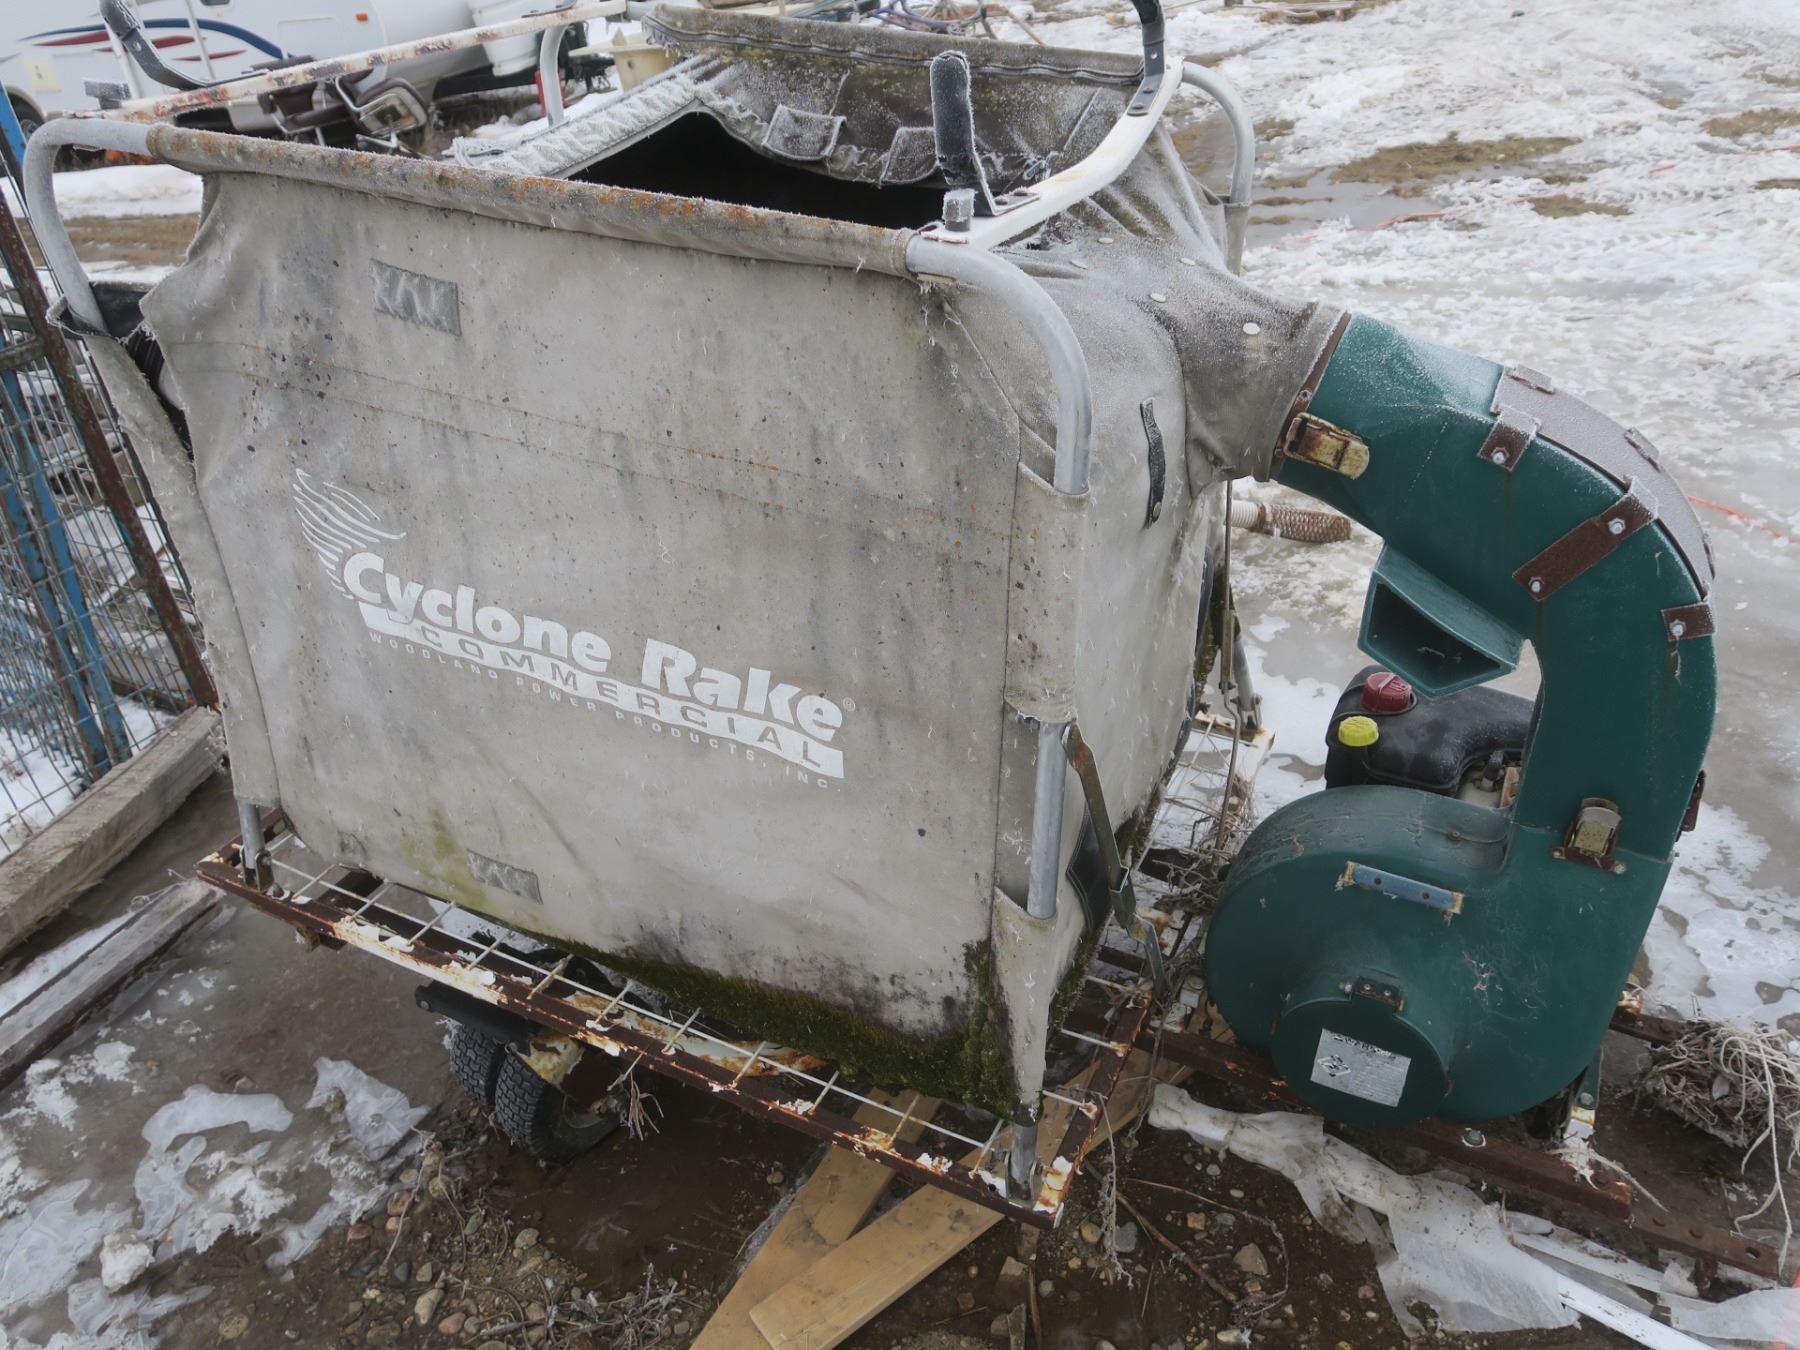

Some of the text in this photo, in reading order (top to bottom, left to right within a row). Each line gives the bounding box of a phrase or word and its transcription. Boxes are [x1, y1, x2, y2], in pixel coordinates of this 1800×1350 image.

[344, 552, 612, 673] Cyclone
[369, 631, 498, 679] WOODLAND
[516, 676, 596, 712] POWER
[420, 625, 822, 768] COMMERCIAL
